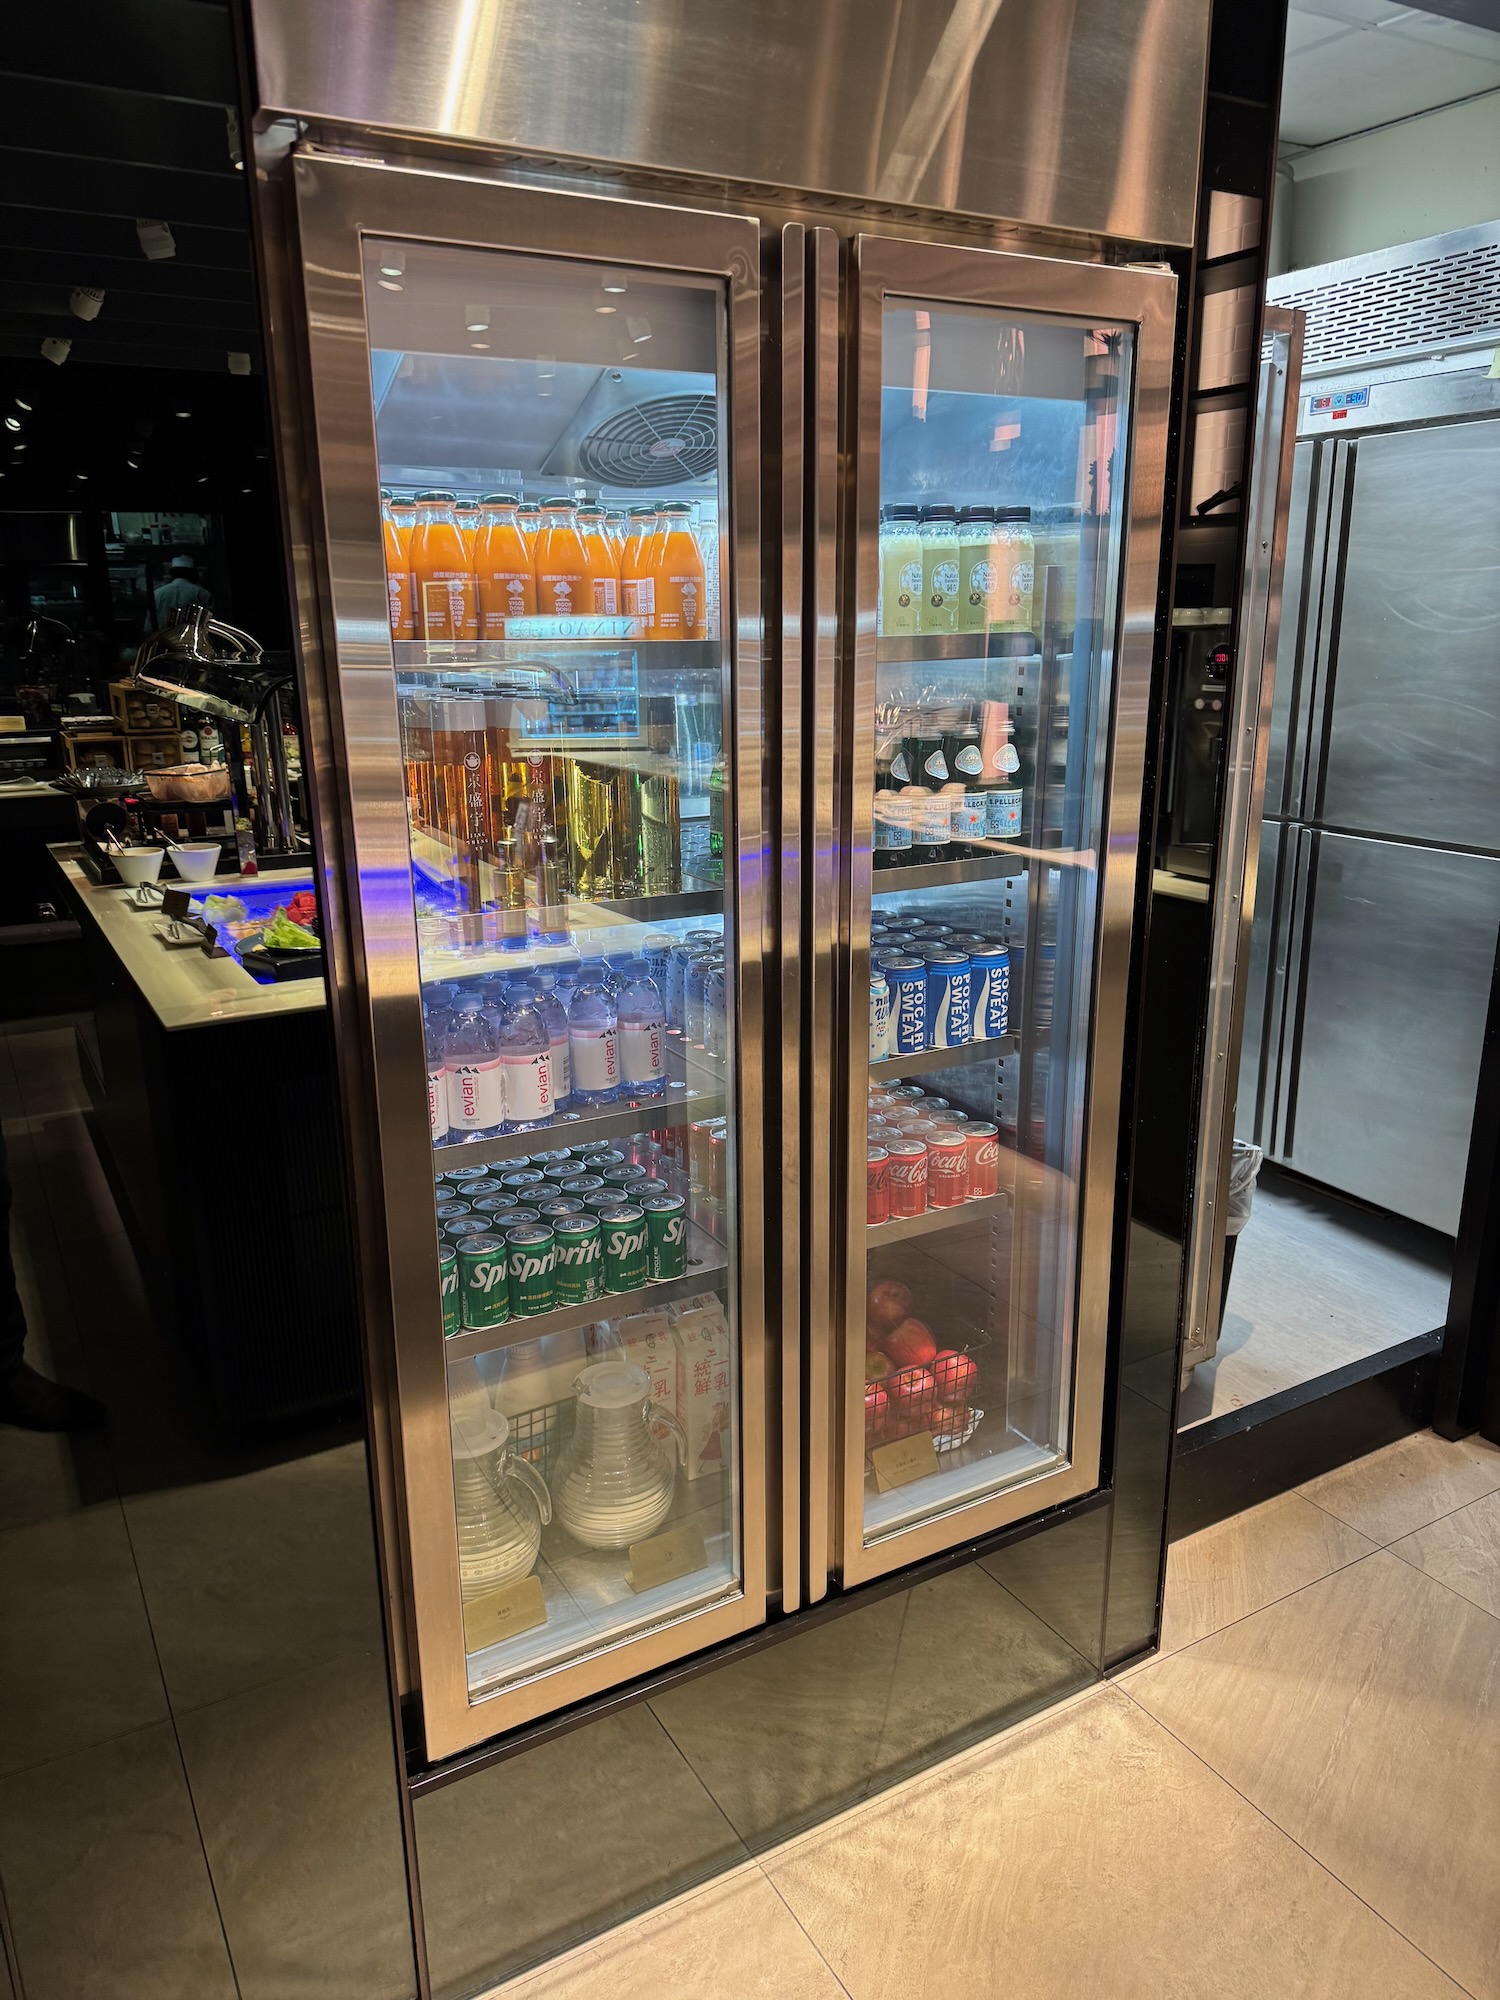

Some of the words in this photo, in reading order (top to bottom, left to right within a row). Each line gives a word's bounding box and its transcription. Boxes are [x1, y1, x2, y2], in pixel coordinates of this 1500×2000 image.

[467, 772, 484, 828] 京盛宇
[901, 982, 915, 1046] SWEAT
[914, 980, 924, 1052] POCARI
[951, 975, 963, 1038] SWEAT
[961, 973, 971, 1043] POCARI
[990, 968, 1002, 1029] SWEAT
[1000, 966, 1010, 1034] POCARI
[604, 1039, 616, 1075] evian
[649, 1031, 661, 1067] evian
[461, 1077, 475, 1116] evian
[538, 1065, 549, 1104] evian
[694, 1358, 729, 1378] 統一
[694, 1371, 730, 1396] 鮮乳
